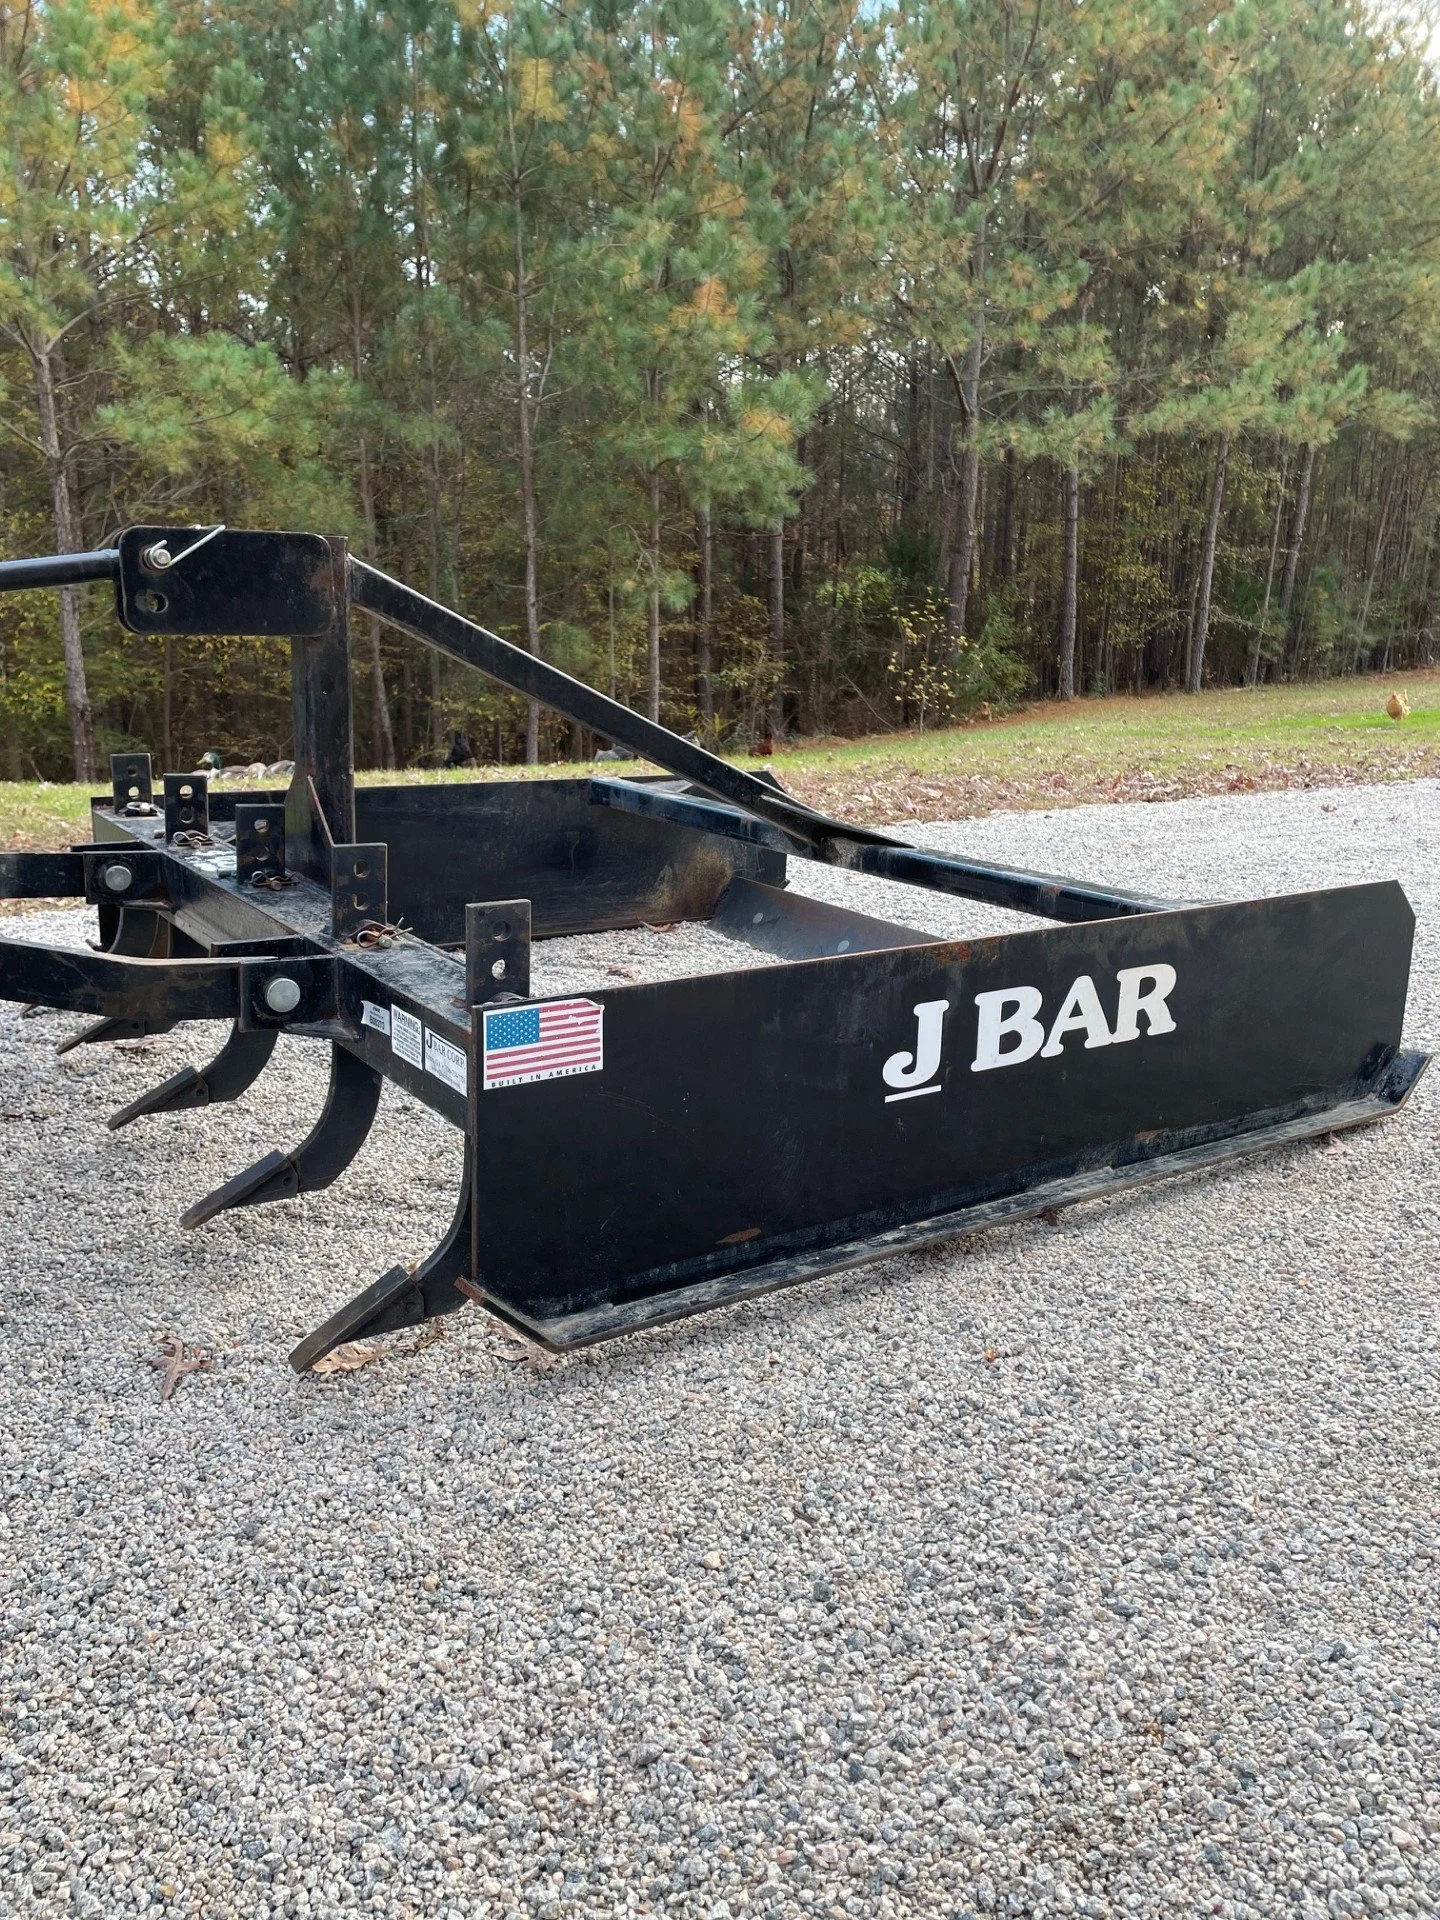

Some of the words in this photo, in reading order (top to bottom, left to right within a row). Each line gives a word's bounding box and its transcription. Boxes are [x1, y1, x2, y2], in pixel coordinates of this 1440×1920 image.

[882, 999, 950, 1088] J
[970, 963, 1177, 1072] BAR
[426, 1031, 433, 1049] J
[433, 1042, 446, 1058] BAR
[491, 1077, 523, 1088] BUILT
[548, 1064, 597, 1078] AMERICA
